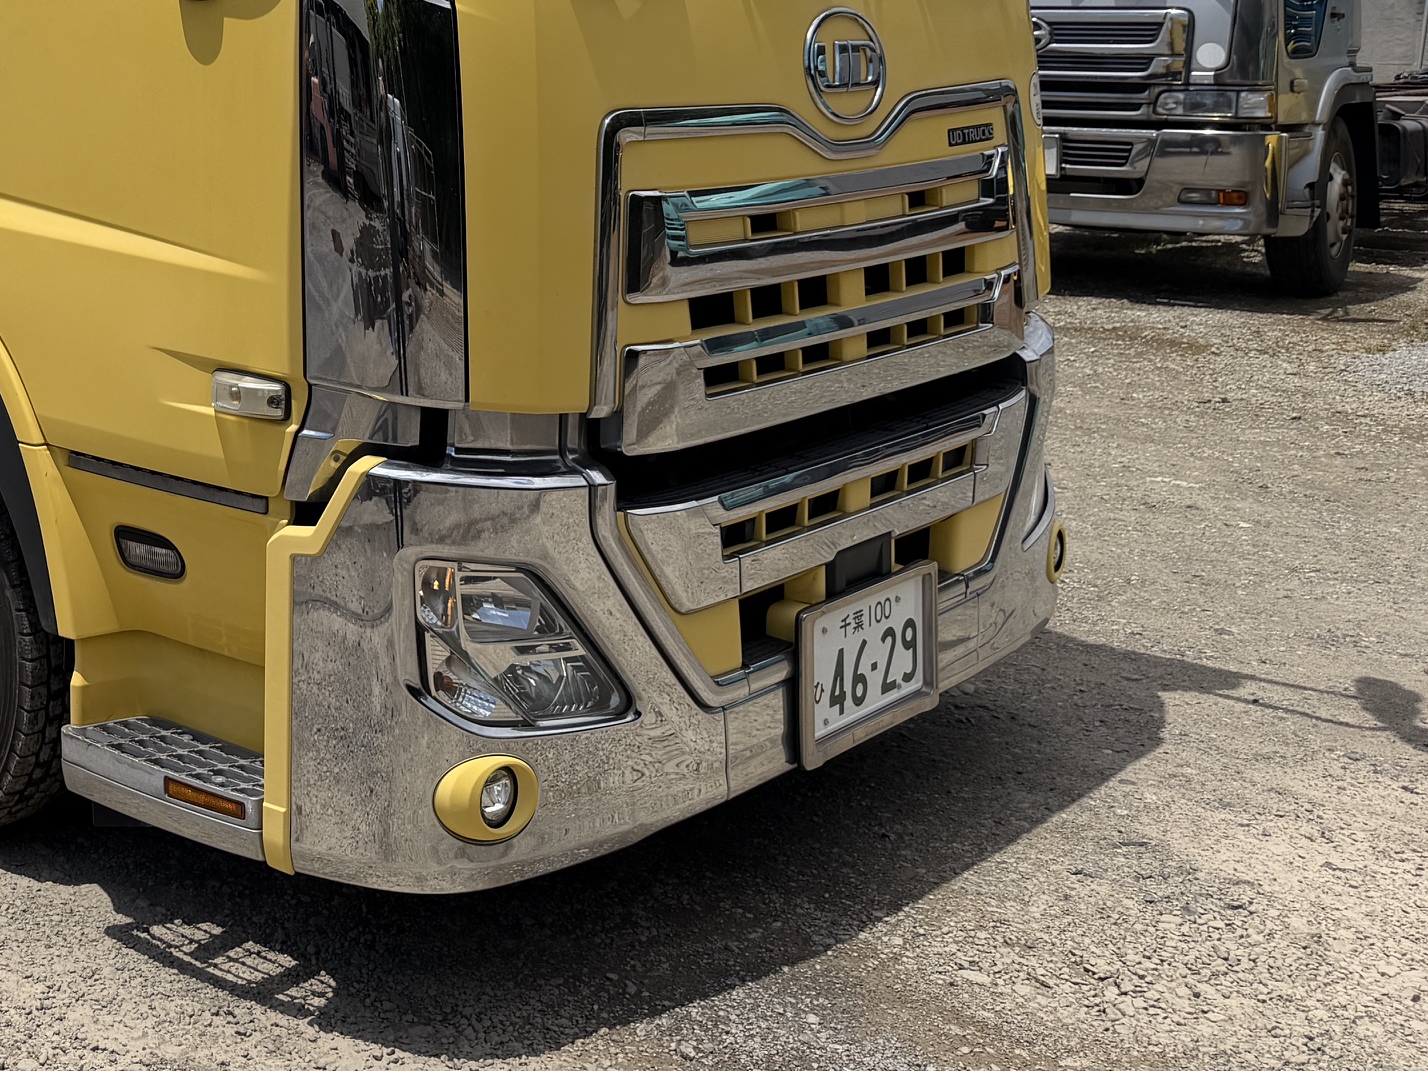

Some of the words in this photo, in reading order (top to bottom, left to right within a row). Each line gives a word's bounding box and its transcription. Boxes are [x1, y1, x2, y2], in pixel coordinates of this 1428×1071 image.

[815, 40, 882, 93] UD
[949, 130, 963, 144] UD
[963, 125, 994, 142] TRUCKS
[829, 617, 918, 716] 46-29
